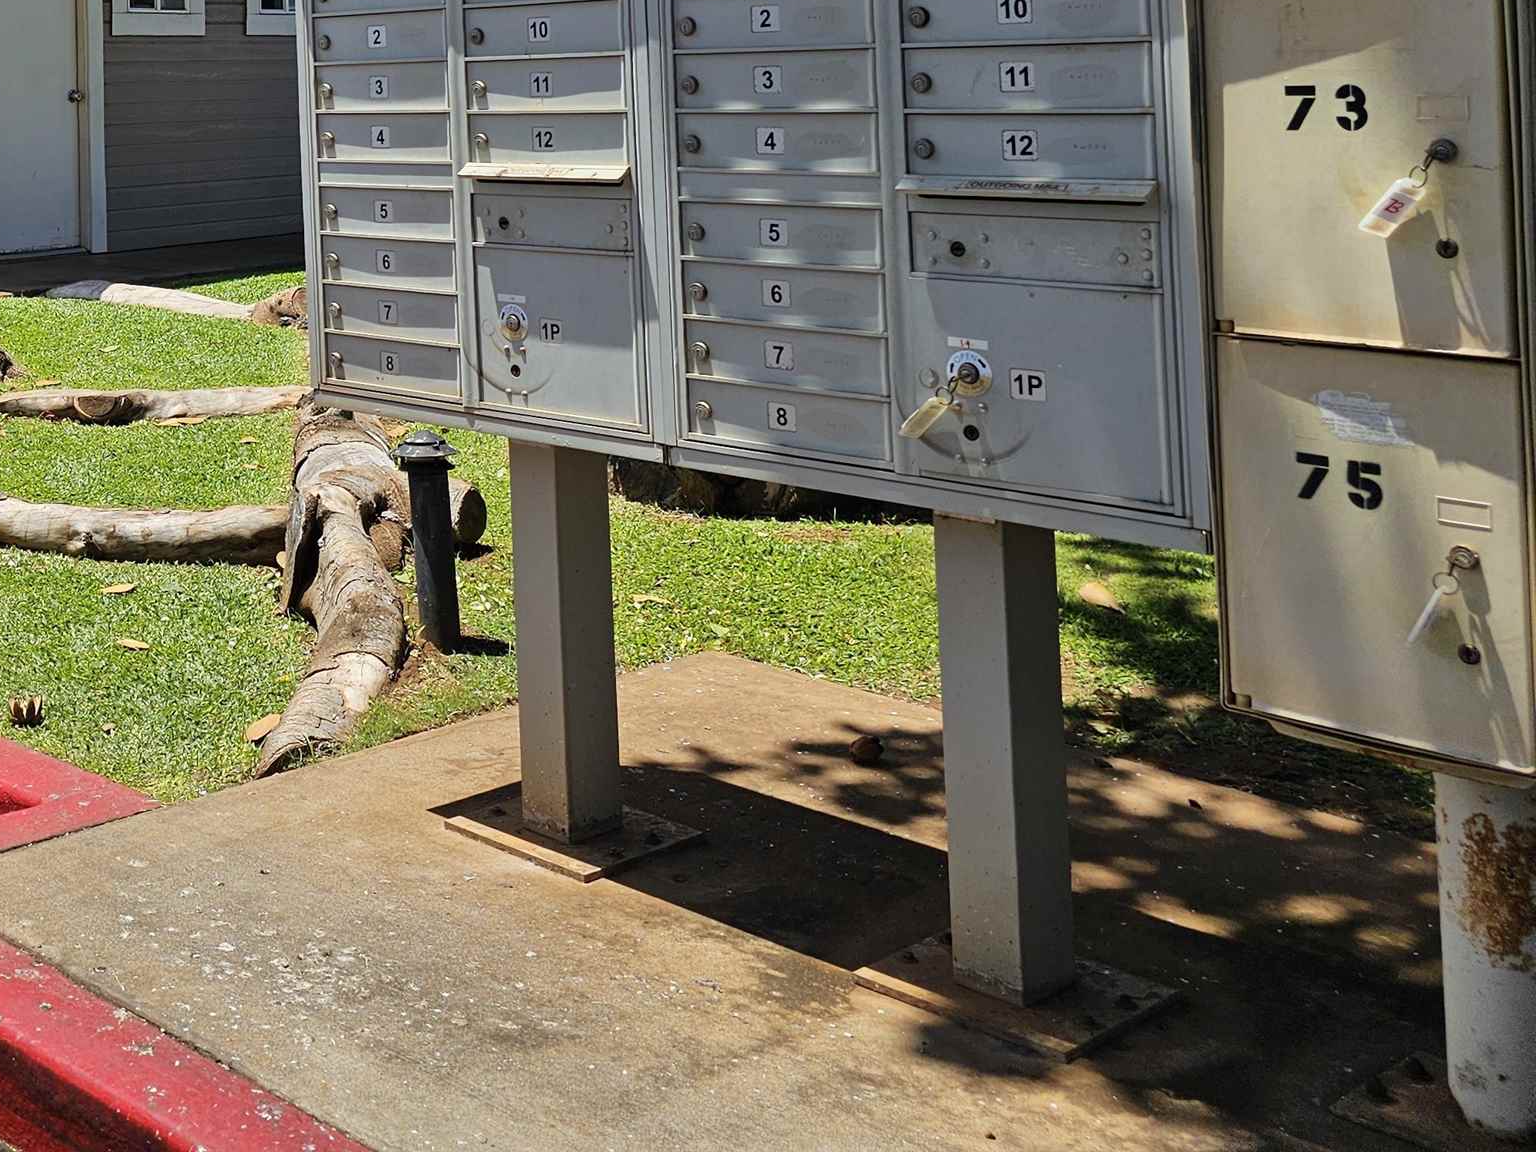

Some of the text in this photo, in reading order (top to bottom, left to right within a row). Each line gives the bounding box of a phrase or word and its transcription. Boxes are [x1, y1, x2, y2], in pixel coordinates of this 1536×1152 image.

[759, 9, 772, 28] 2
[372, 29, 382, 45] 2
[529, 20, 548, 39] 10
[533, 75, 549, 93] 11
[762, 70, 774, 90] 3
[1005, 65, 1030, 87] 11
[375, 79, 384, 95] 3
[1284, 84, 1368, 132] 73
[376, 129, 385, 145] 4
[535, 130, 553, 148] 12
[763, 131, 777, 151] 4
[1005, 134, 1035, 156] 12
[379, 203, 388, 219] 5
[768, 223, 780, 242] 5
[382, 254, 391, 270] 6
[770, 284, 783, 304] 6
[383, 304, 392, 321] 7
[541, 322, 560, 341] 1P
[385, 355, 394, 372] 8
[772, 345, 785, 365] 7
[1013, 373, 1043, 396] 1P
[776, 407, 788, 427] 8
[1296, 452, 1383, 510] 75
